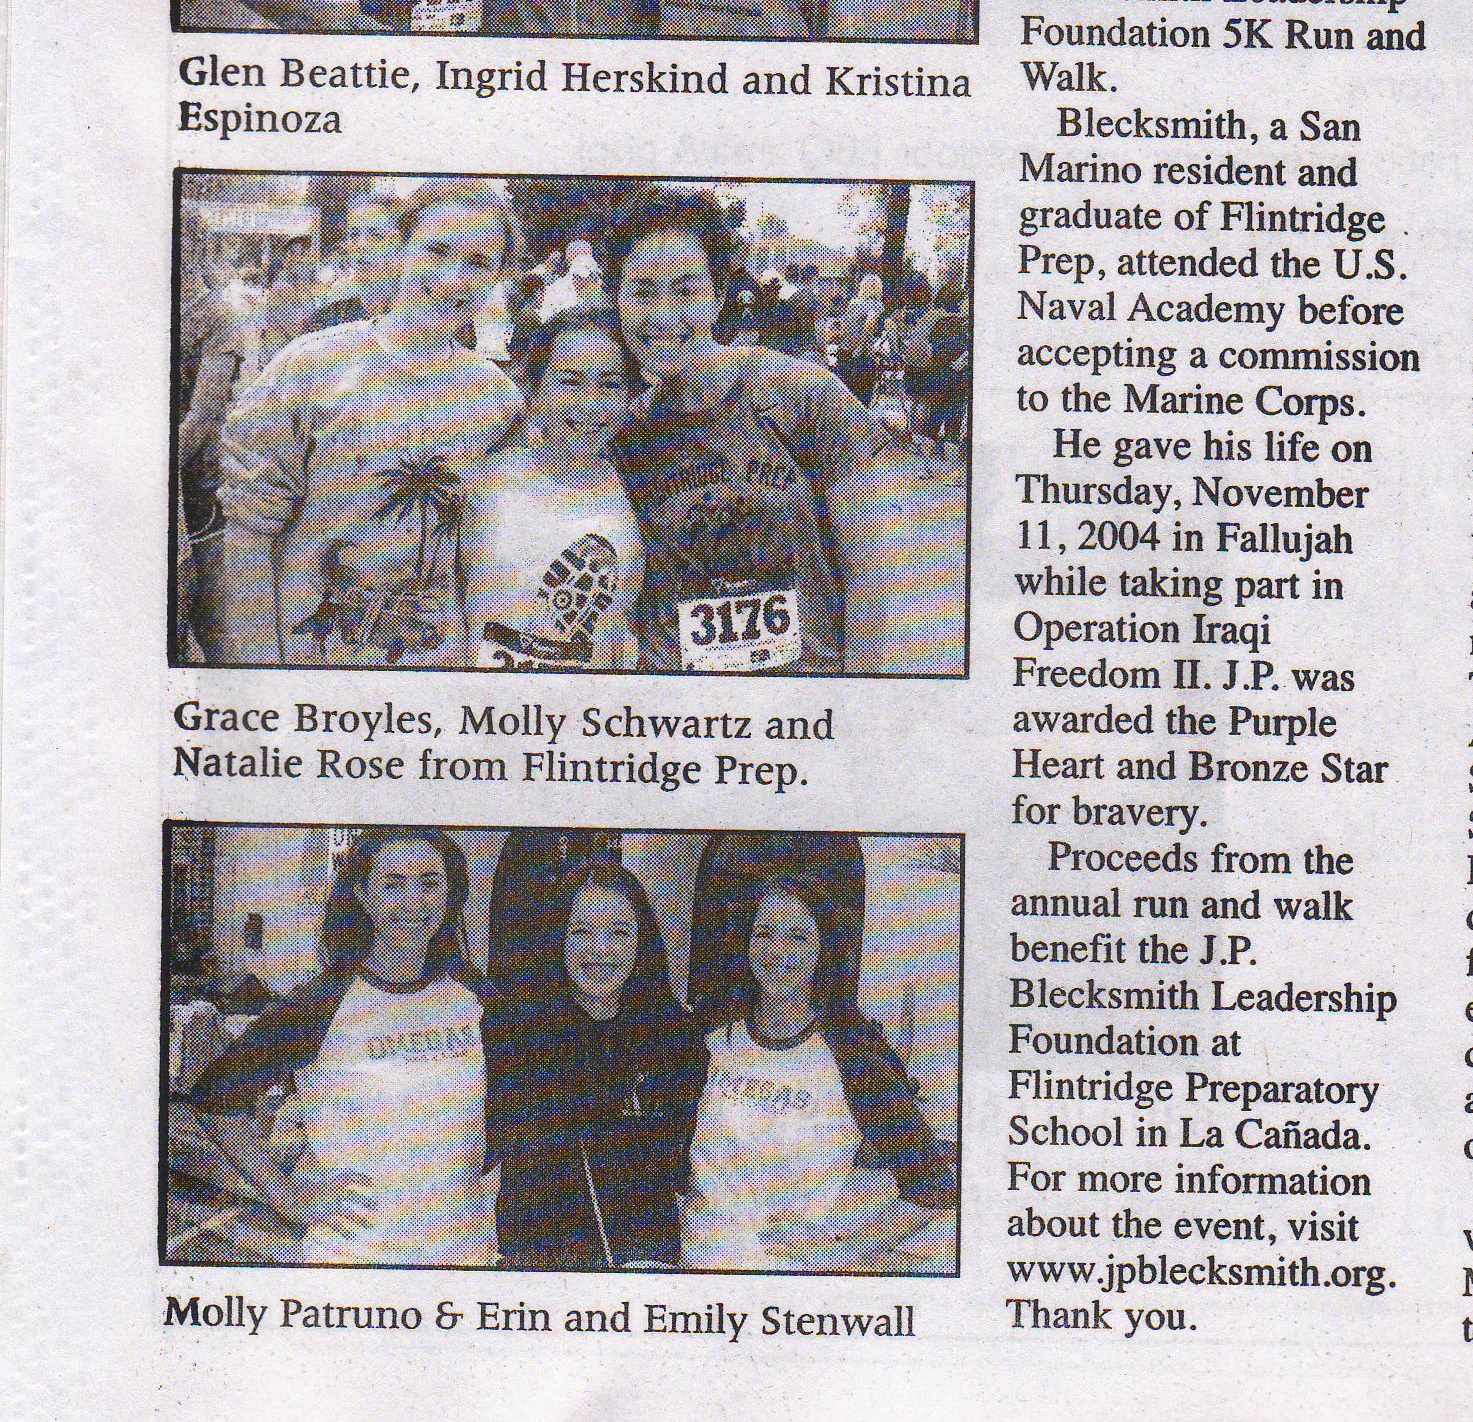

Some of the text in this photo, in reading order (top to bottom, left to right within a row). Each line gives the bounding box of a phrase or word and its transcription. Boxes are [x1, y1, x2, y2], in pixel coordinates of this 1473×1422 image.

[1021, 15, 1427, 51] Foundation 5K Run and
[179, 53, 971, 99] Glen Beattie, Ingrid Herskind and Kristina
[1020, 60, 1117, 93] Walk.
[178, 100, 342, 141] Espinoza
[1057, 106, 1361, 146] Blecksmith, a San
[1019, 152, 1358, 188] Marino resident and
[1019, 198, 1386, 243] graduate of Flintridge
[1018, 244, 1407, 284] Prep, attended the U.S.
[1017, 290, 1404, 333] Naval Academy before
[1017, 337, 1421, 377] accepting a commission
[1016, 382, 1366, 426] to the Marine Corps.
[1053, 427, 1373, 468] He gave his life on
[1014, 473, 1370, 515] Thursday, November
[1019, 519, 1354, 563] 11, 2004 in Fallujah
[690, 594, 791, 648] 3176
[1014, 610, 1271, 654] Operation Iraqi
[1013, 656, 1355, 692] Freedom II. J.P. was
[173, 700, 834, 745] Grace Broyles, Molly Schwartz and
[1013, 703, 1337, 746] awarded the Purple
[173, 745, 808, 794] Natalie Rose from Flintridge Prep.
[1012, 748, 1390, 784] Heart and Bronze Star
[1048, 840, 1354, 876] Proceeds from the
[1009, 931, 1257, 966] benefit the J.P.
[1009, 977, 1398, 1022] Blecksmith Leadership
[366, 1023, 478, 1061] OMEGAS
[1009, 1023, 1242, 1057] Foundation at
[1008, 1069, 1380, 1113] Flintridge Preparatory
[1008, 1114, 1371, 1151] School in La Cañada.
[1007, 1161, 1371, 1196] For more information
[1007, 1253, 1396, 1297] www.jpblecksmith.org.
[163, 1295, 915, 1343] Molly Patruno & Erin and Emily Stenwall
[1005, 1298, 1197, 1339] Thank you.
